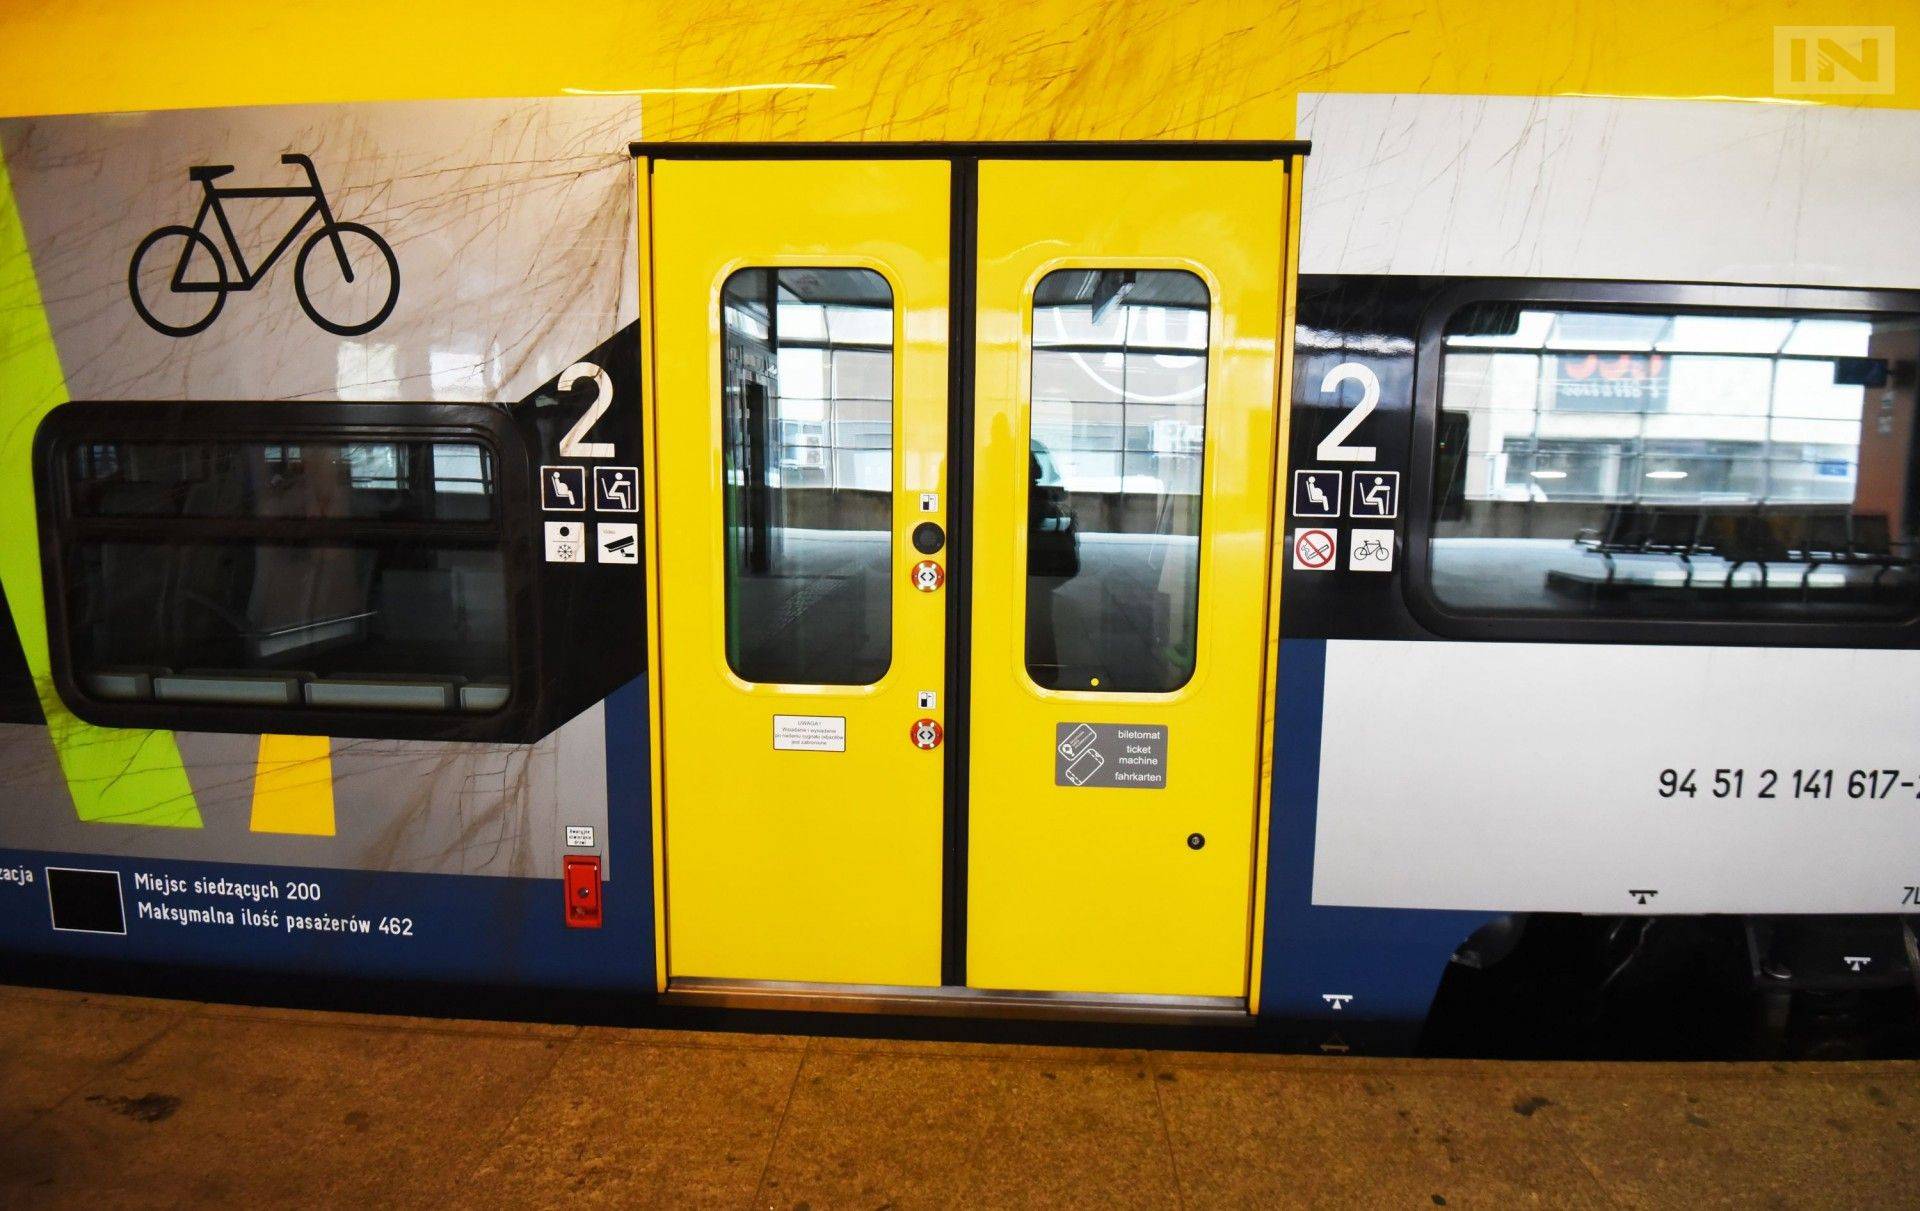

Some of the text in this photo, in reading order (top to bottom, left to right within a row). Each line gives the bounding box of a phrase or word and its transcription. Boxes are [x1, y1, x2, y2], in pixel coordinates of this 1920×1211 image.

[557, 361, 615, 458] 2
[1316, 362, 1381, 462] 2
[1118, 730, 1161, 740] biletomat
[1126, 745, 1152, 754] ticket
[1118, 756, 1158, 765] machine
[1115, 771, 1162, 782] fahrkarten
[1658, 768, 1920, 799] 94 51 2 141 617-
[134, 872, 321, 901] Miejsc siedzących 200
[137, 901, 414, 936] Maksymalna ilość pasażerów 462
